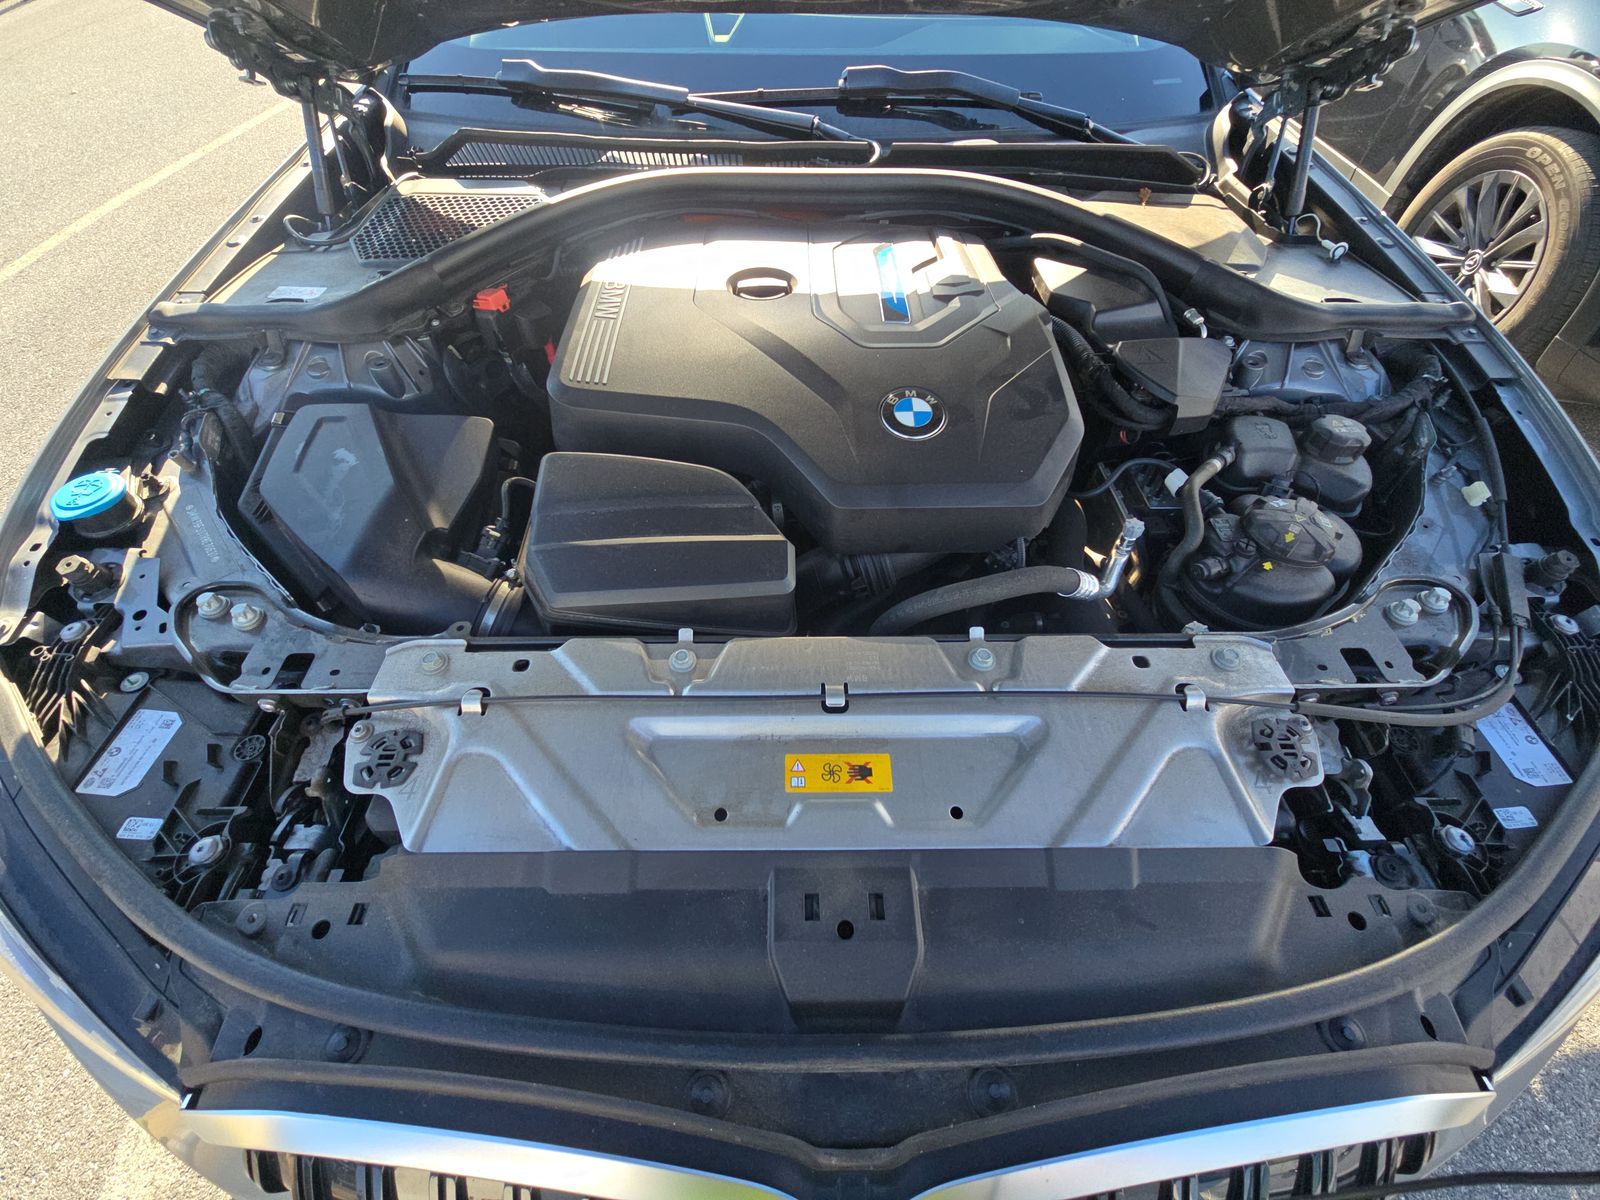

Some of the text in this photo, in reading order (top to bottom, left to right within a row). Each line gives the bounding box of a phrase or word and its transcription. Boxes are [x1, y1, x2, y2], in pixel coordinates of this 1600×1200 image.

[1526, 146, 1566, 190] OPEN
[594, 281, 626, 319] BMW
[887, 390, 938, 405] BMW
